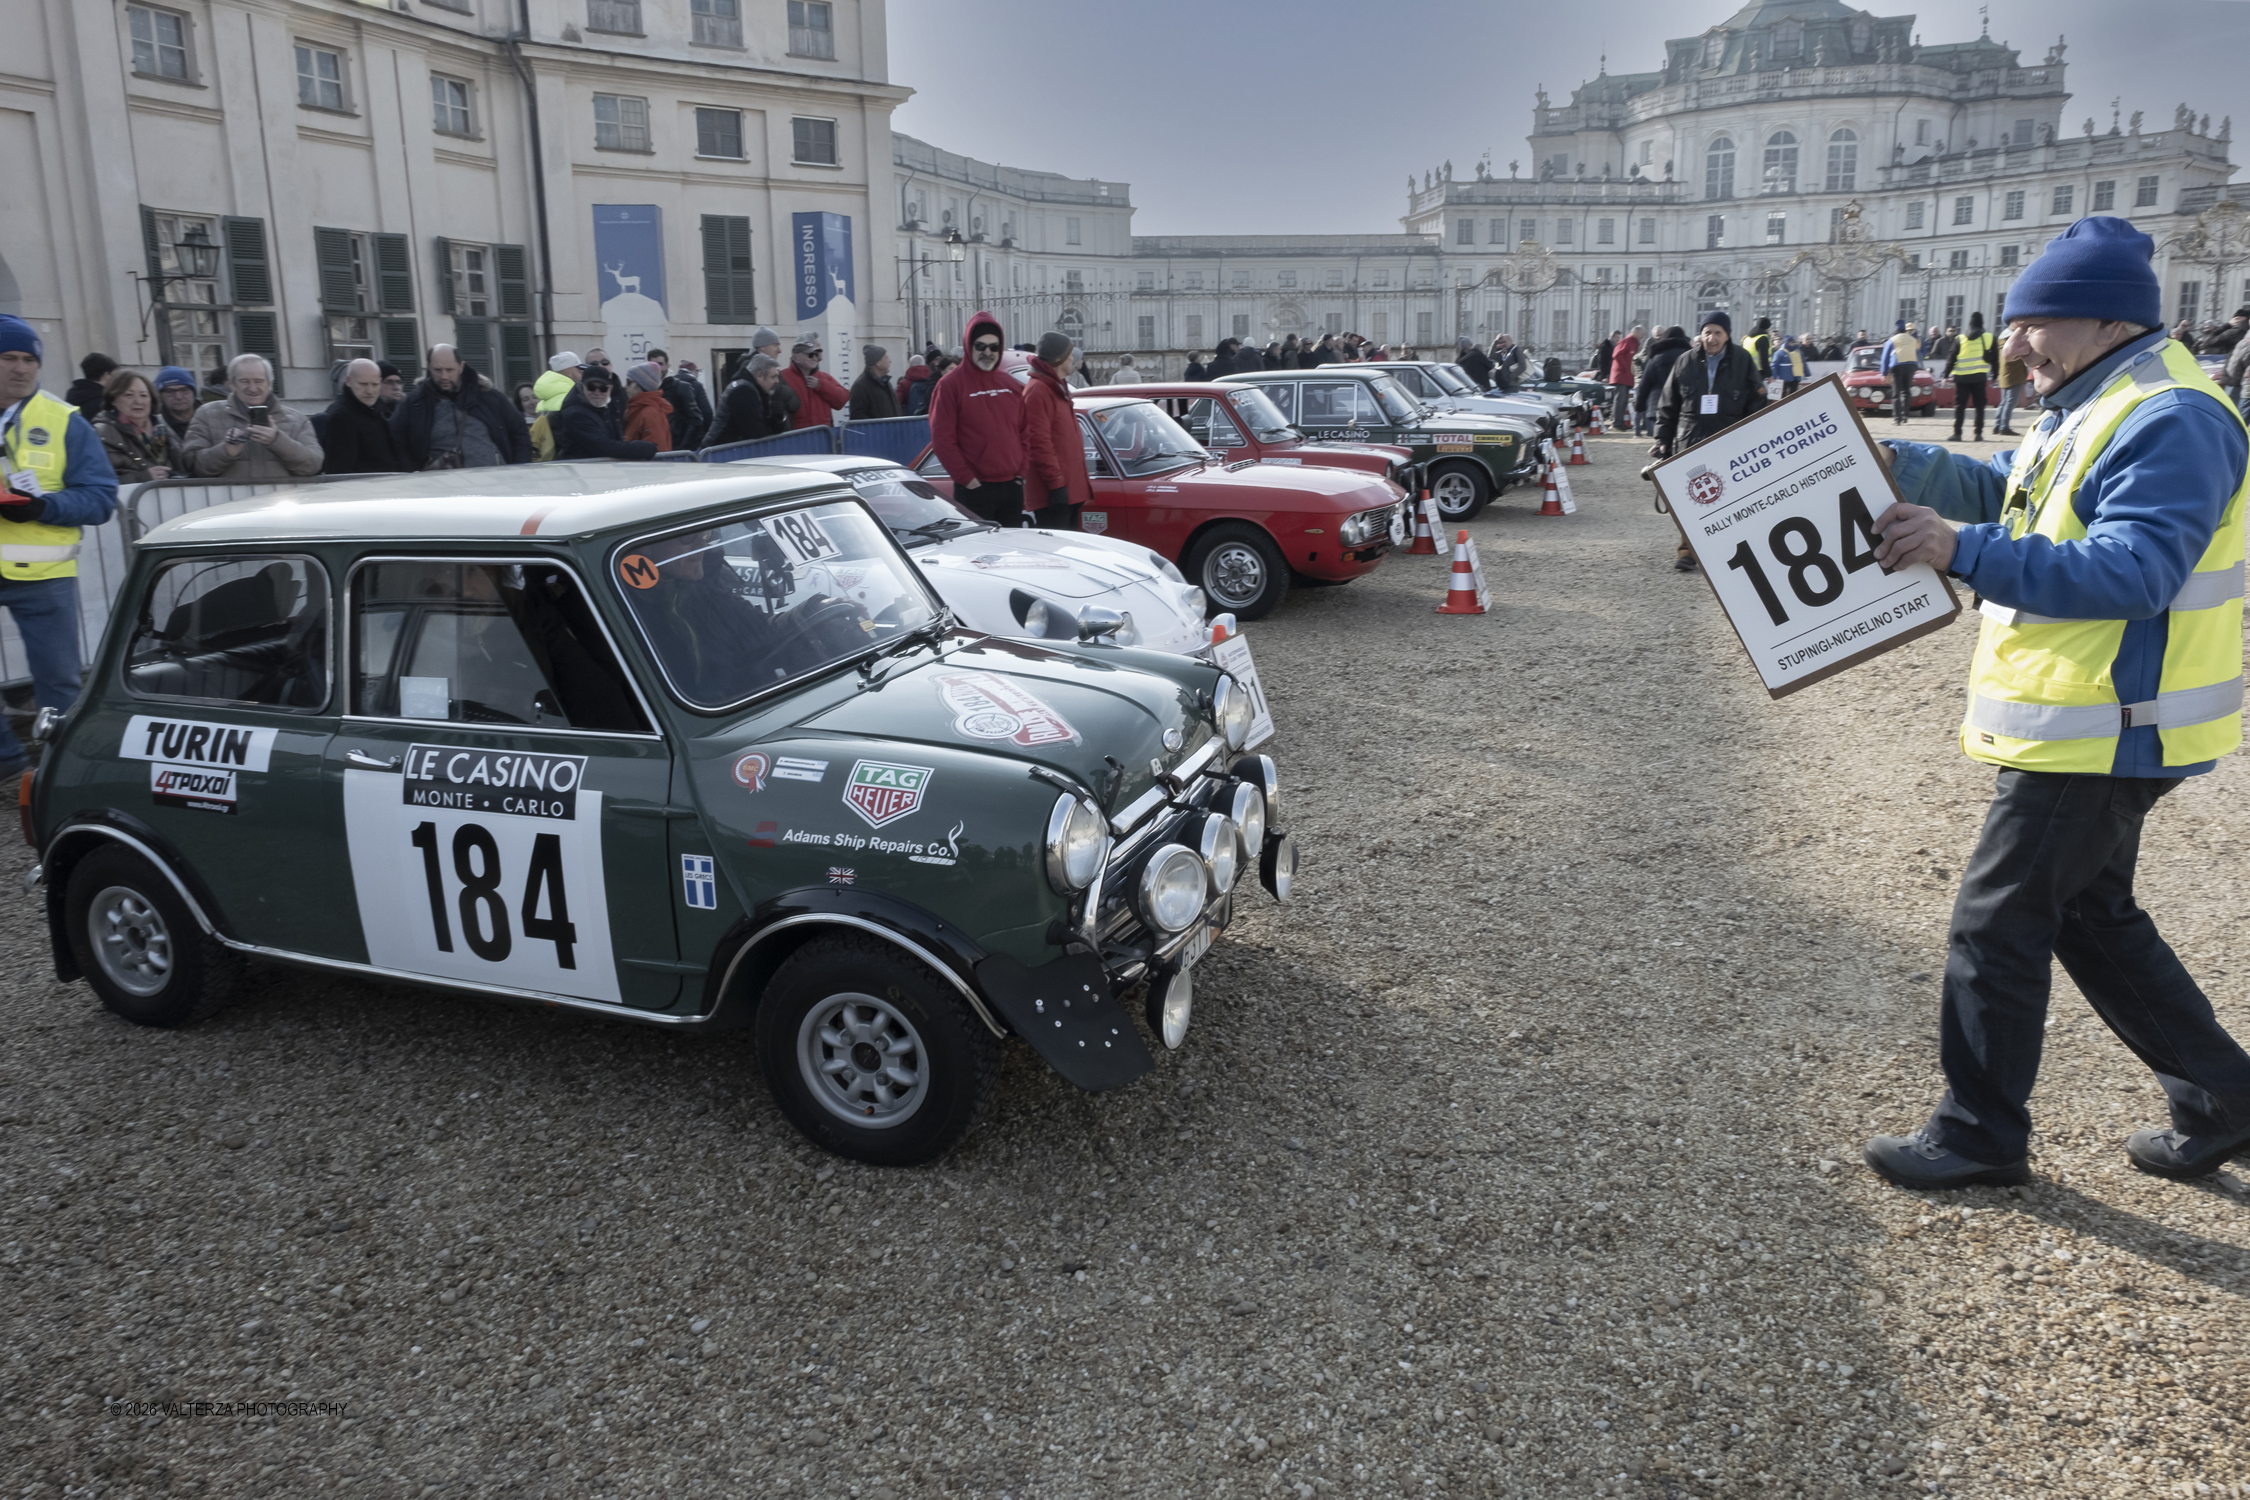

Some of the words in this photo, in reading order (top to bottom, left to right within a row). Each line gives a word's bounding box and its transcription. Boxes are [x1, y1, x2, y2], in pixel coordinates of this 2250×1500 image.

[801, 224, 818, 308] INGRESSO
[1318, 430, 1330, 439] LE
[1330, 430, 1370, 439] CASINO
[1434, 435, 1471, 443] TOTAL
[1728, 412, 1830, 470] AUTOMOBILE
[1732, 458, 1772, 483] CLUB
[1776, 424, 1838, 460] TORINO
[1704, 511, 1733, 537] RALLY
[1733, 482, 1799, 523] MONTE-CARLO
[1800, 454, 1857, 491] HISTORIQUE
[772, 513, 835, 560] 184
[1727, 487, 1896, 627] 184
[623, 557, 656, 587] M
[1777, 611, 1893, 671] STUPINIGI-NICHELINO
[1893, 594, 1931, 621] START
[957, 695, 996, 712] 184
[145, 722, 253, 765] TURIN
[406, 749, 440, 780] LE
[447, 752, 578, 793] CASINO
[742, 764, 760, 772] BMC
[863, 766, 919, 788] TAG
[413, 789, 474, 808] MONTE
[502, 797, 564, 817] CARLO
[852, 787, 914, 818] HEUER
[783, 829, 830, 845] Adams
[834, 834, 866, 850] Ship
[869, 837, 923, 856] Repairs
[927, 842, 952, 857] Co.
[411, 821, 577, 970] 184
